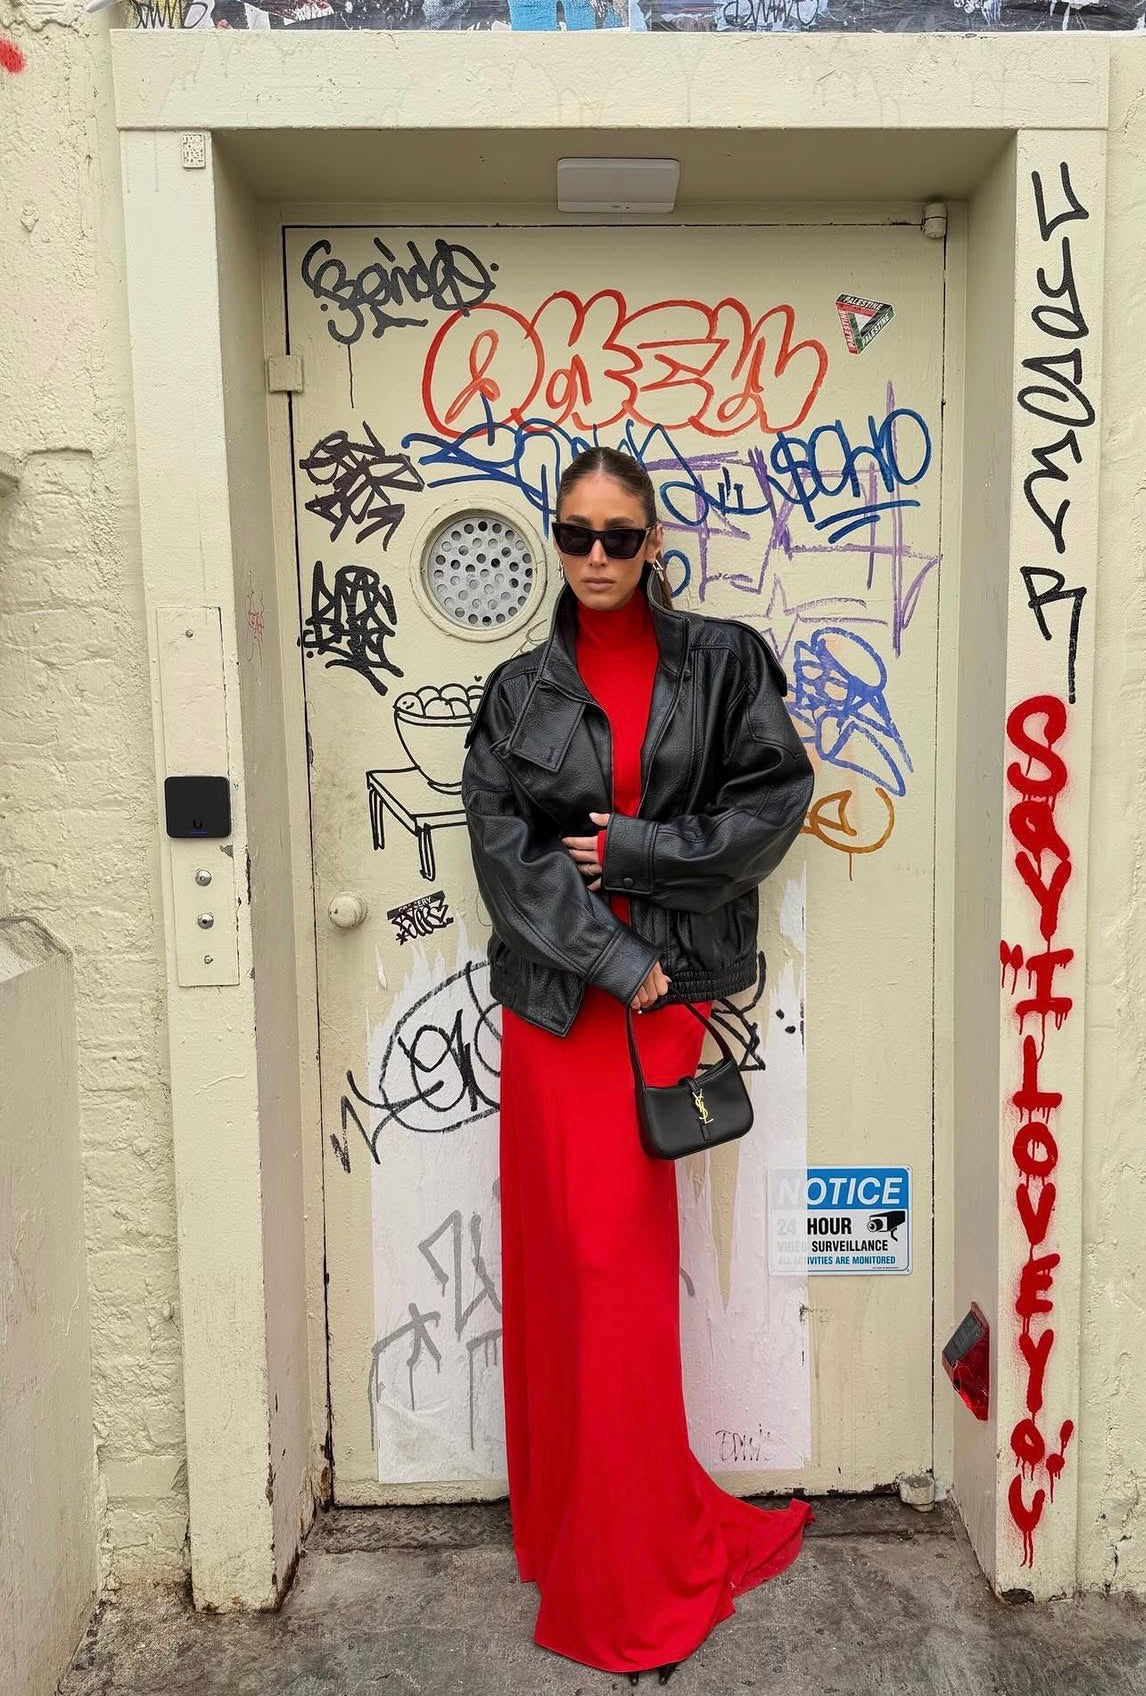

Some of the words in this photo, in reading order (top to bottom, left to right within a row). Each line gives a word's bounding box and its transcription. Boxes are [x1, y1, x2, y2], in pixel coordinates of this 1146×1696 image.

[843, 296, 884, 312] PALESTINE
[861, 312, 890, 347] PALESTINE
[1011, 1034, 1063, 1317] LOVE
[779, 1177, 903, 1205] NOTICE
[806, 1217, 852, 1235] HOUR
[811, 1240, 888, 1252] SURVEILLANCE
[835, 1256, 850, 1265] ARE
[852, 1256, 896, 1265] MONITORED
